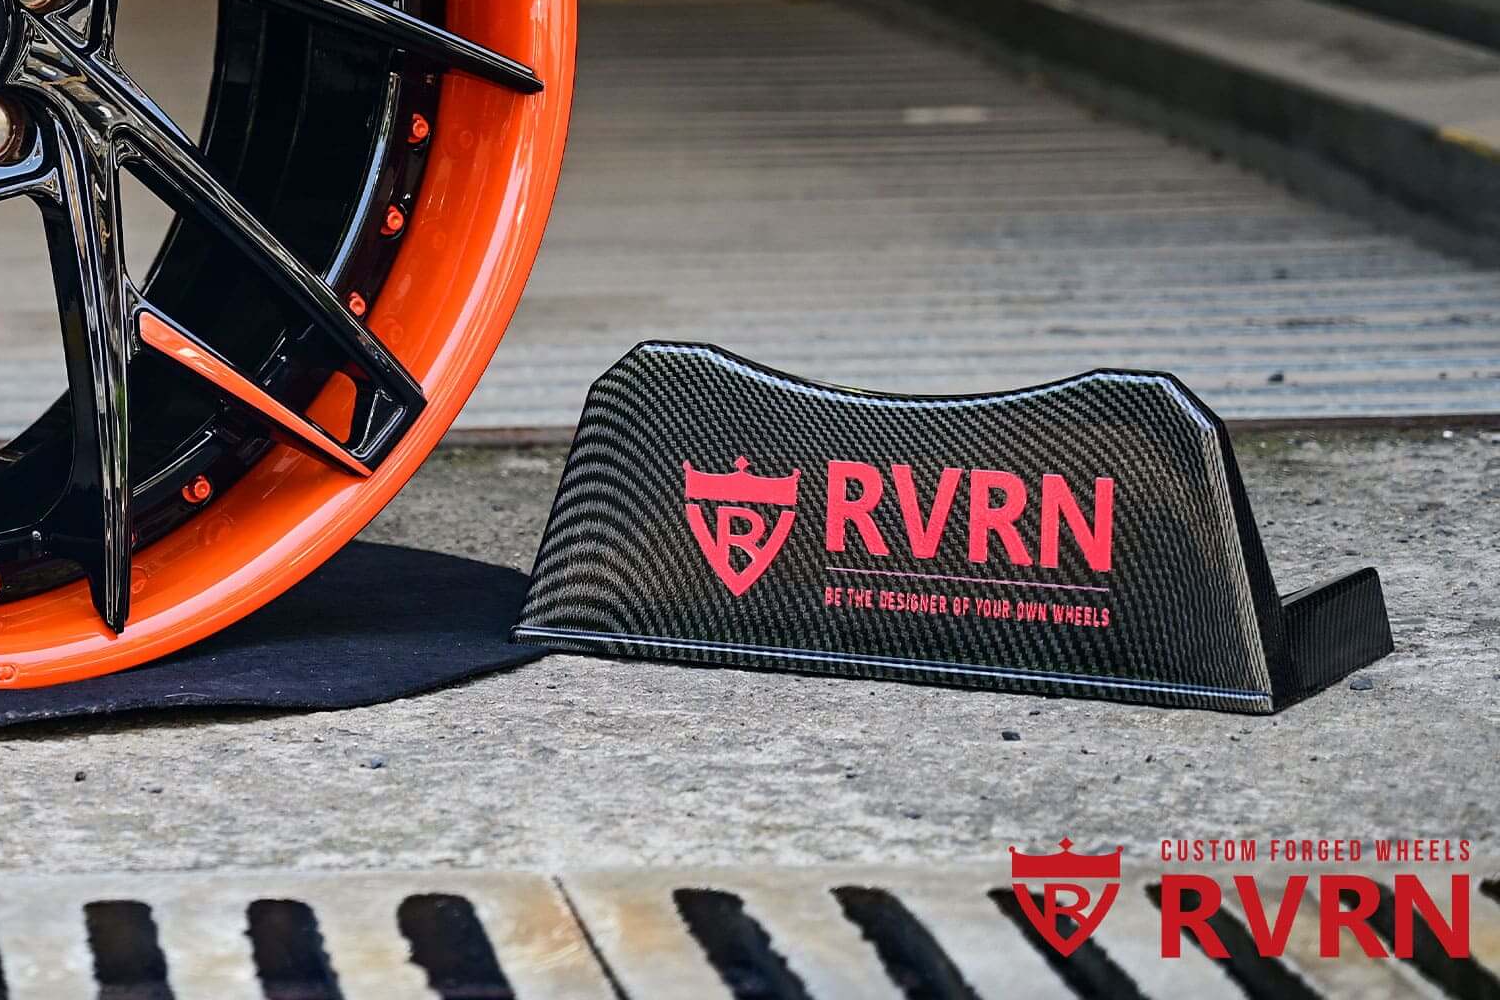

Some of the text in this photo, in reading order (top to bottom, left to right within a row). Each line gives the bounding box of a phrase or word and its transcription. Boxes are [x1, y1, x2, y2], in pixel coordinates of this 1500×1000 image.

[826, 460, 1114, 572] RVRN
[825, 586, 1110, 628] BE THE DESIGNER OF YOUR OWN WHEELS
